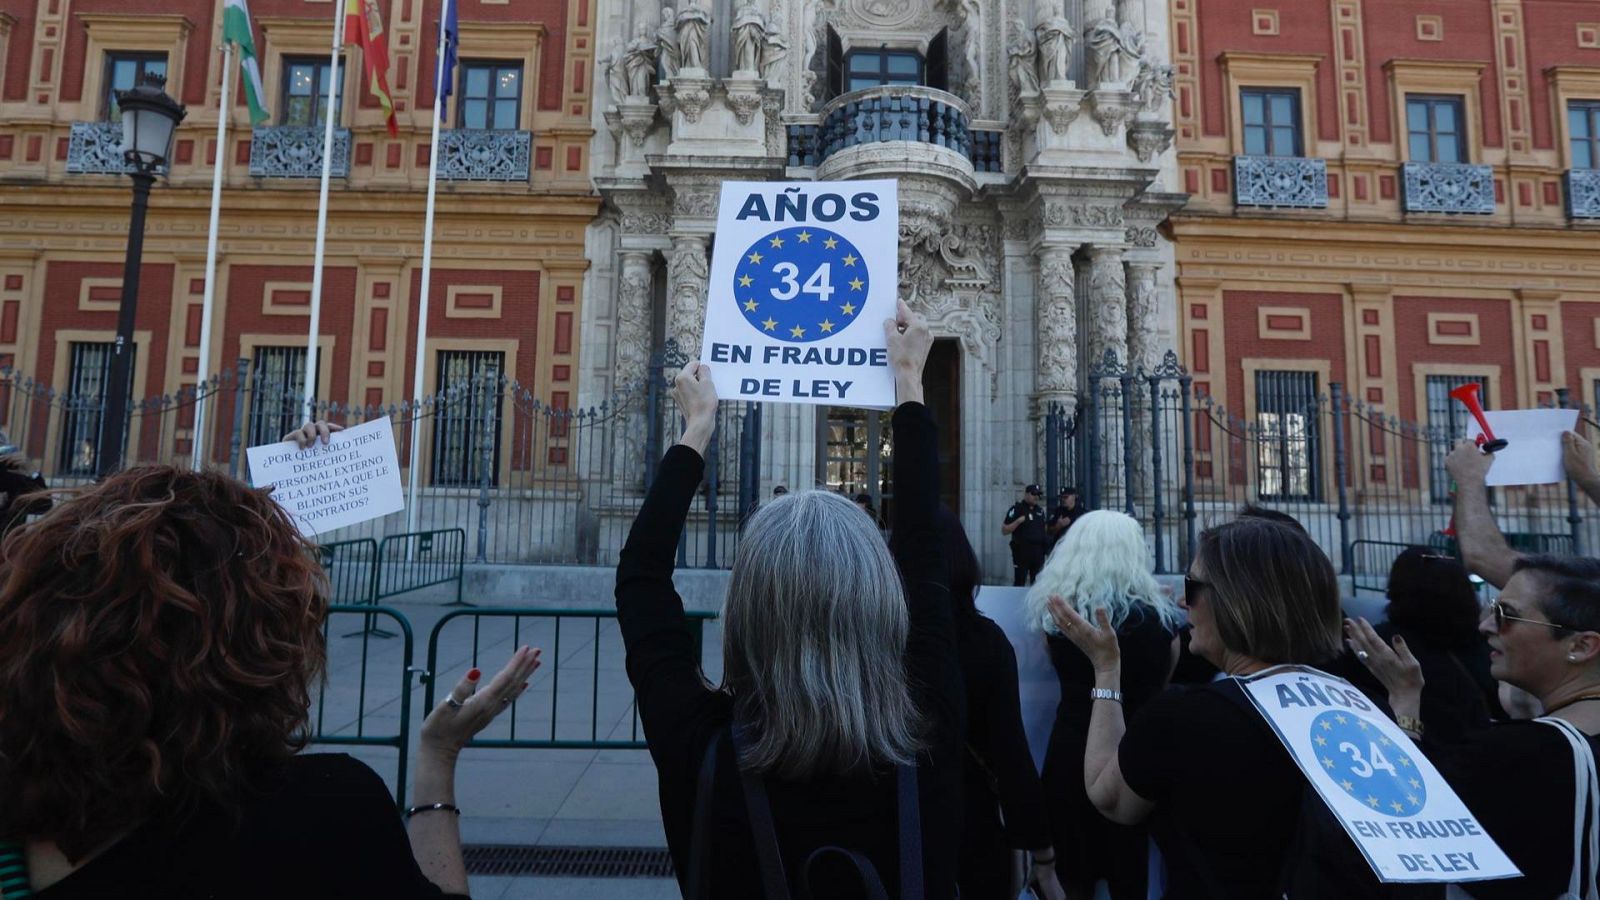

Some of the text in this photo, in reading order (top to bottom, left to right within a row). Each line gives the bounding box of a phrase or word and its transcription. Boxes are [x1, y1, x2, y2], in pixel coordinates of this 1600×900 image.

[736, 187, 880, 222] AÑOS
[770, 262, 835, 301] 34
[711, 343, 888, 366] EN FRAUDE
[740, 378, 853, 398] DE LEY
[263, 453, 292, 468] ¿POR
[322, 440, 351, 454] SOLO
[353, 431, 383, 447] TIENE
[293, 450, 362, 474] DERECHO EL
[334, 456, 384, 476] EXTERNO
[288, 489, 304, 500] LA
[306, 481, 341, 497] JUNTA
[342, 478, 350, 487] A
[352, 471, 374, 485] QUE
[376, 467, 389, 477] LE
[297, 485, 369, 511] BLINDEN SUS
[1275, 677, 1372, 713] AÑOS
[1339, 742, 1397, 778] 34
[1352, 818, 1481, 839] EN FRAUDE
[1398, 852, 1480, 872] DE LEY
